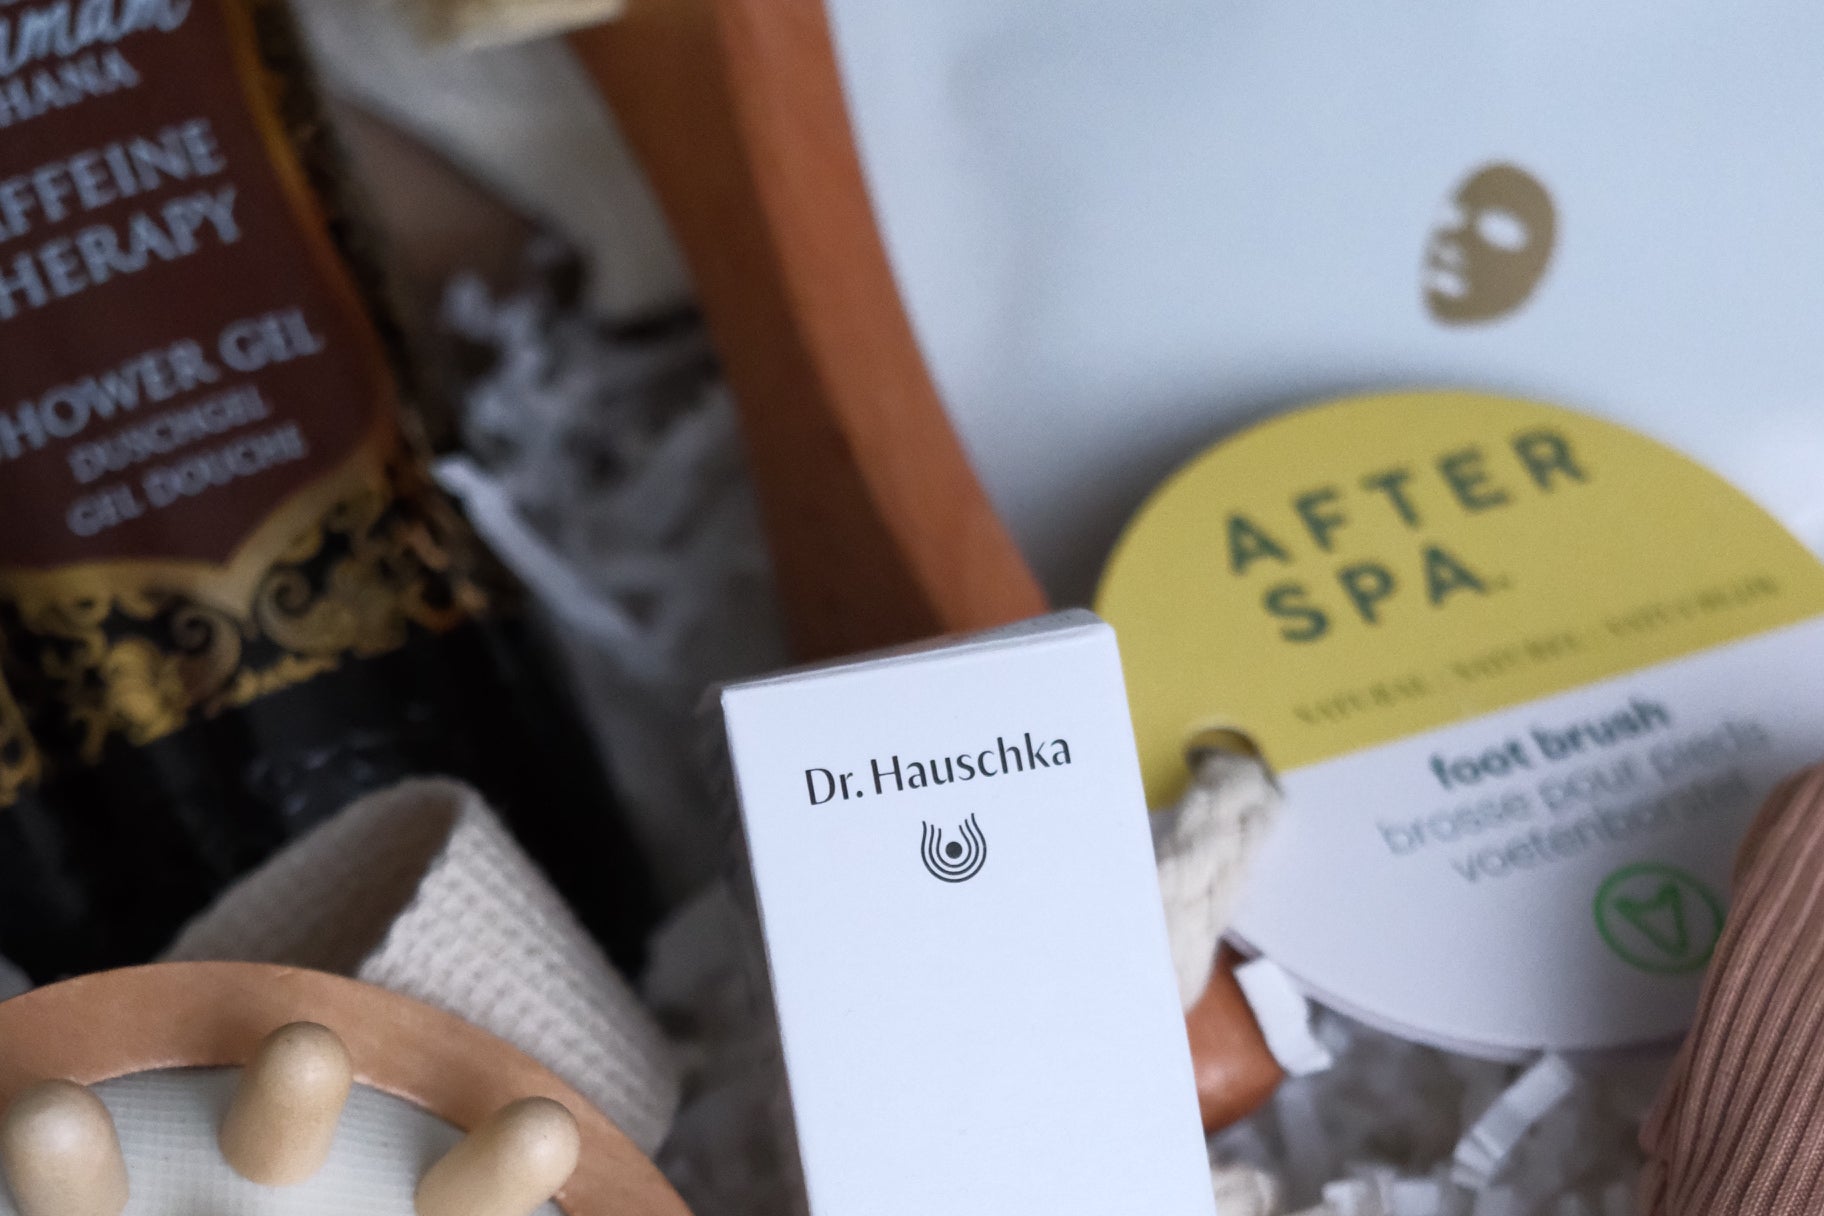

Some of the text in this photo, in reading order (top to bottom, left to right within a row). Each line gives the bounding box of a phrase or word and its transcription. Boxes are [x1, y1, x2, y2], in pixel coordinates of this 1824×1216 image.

[1222, 424, 1593, 576] AFTER
[1260, 540, 1490, 645] SPA
[805, 732, 1071, 806] Dr. Hauschka
[1429, 695, 1671, 791] foot brush
